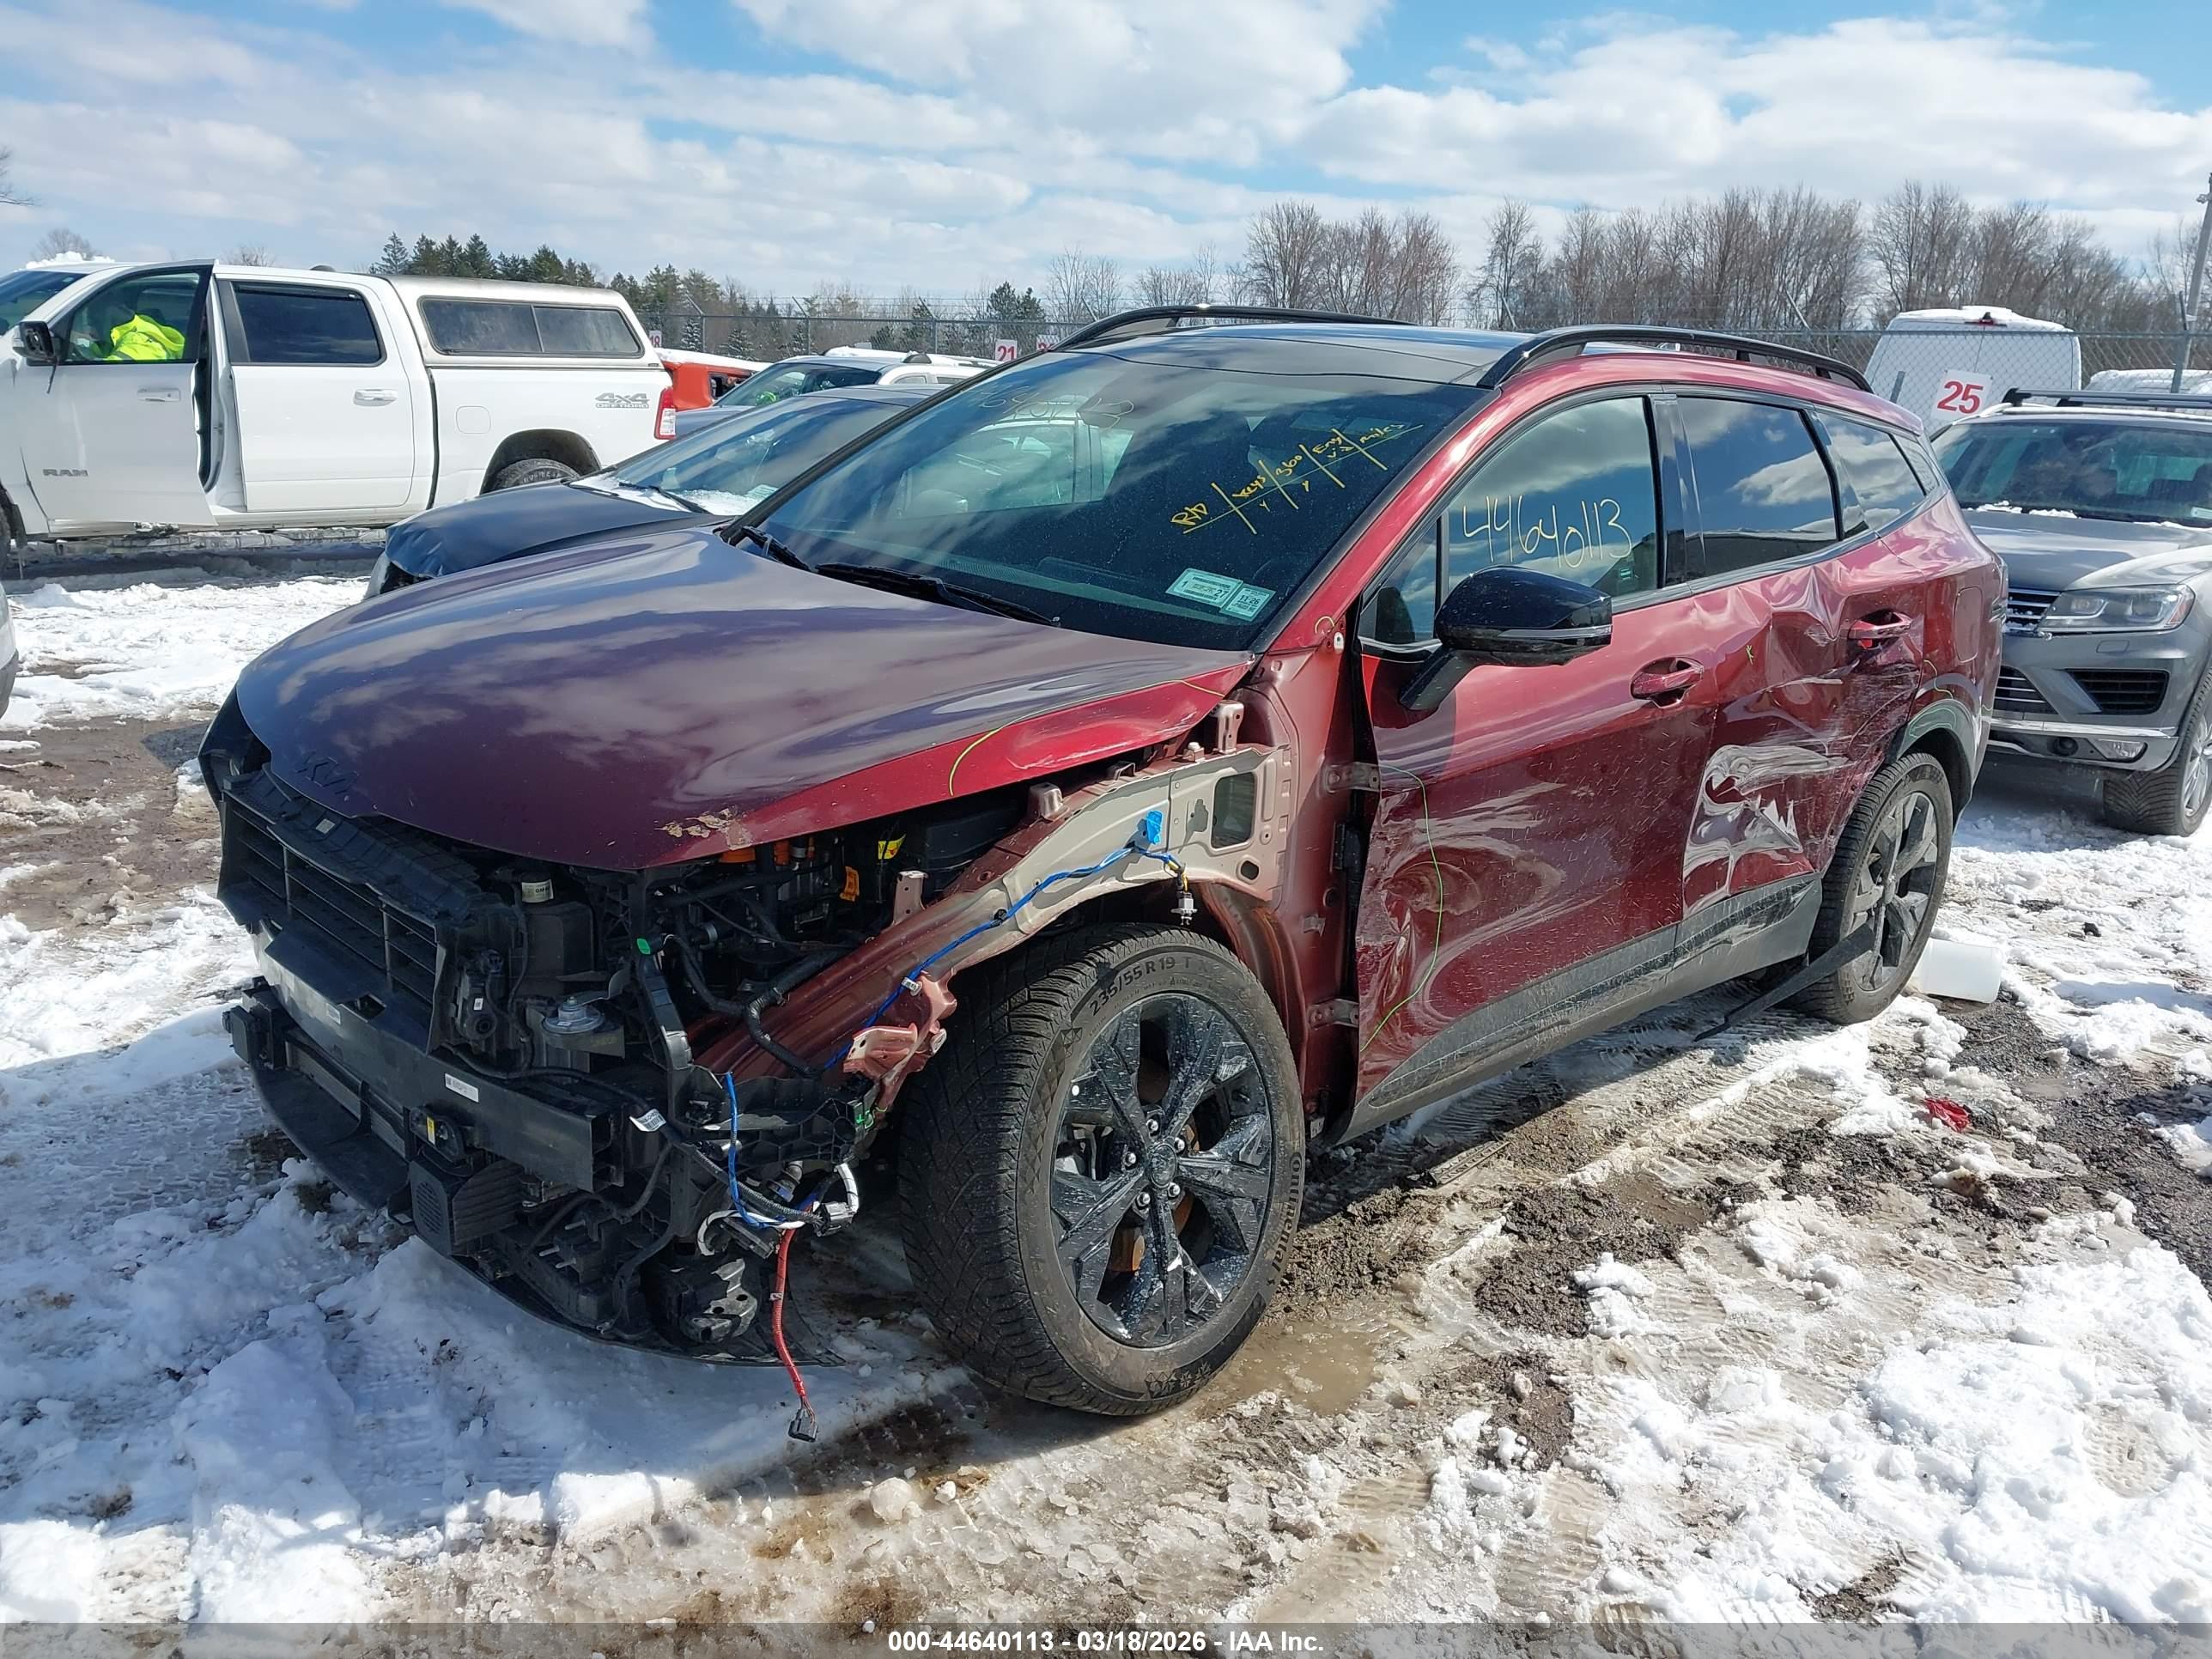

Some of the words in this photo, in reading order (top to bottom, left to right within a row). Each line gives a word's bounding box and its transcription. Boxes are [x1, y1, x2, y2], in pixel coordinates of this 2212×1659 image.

[997, 345, 1015, 361] 21
[1937, 380, 1984, 414] 25
[1275, 454, 1304, 477] 360
[1463, 495, 1632, 568] 44640113
[1214, 589, 1229, 599] 27
[1089, 966, 1144, 1017] 235/55
[1271, 1152, 1303, 1273] Continental
